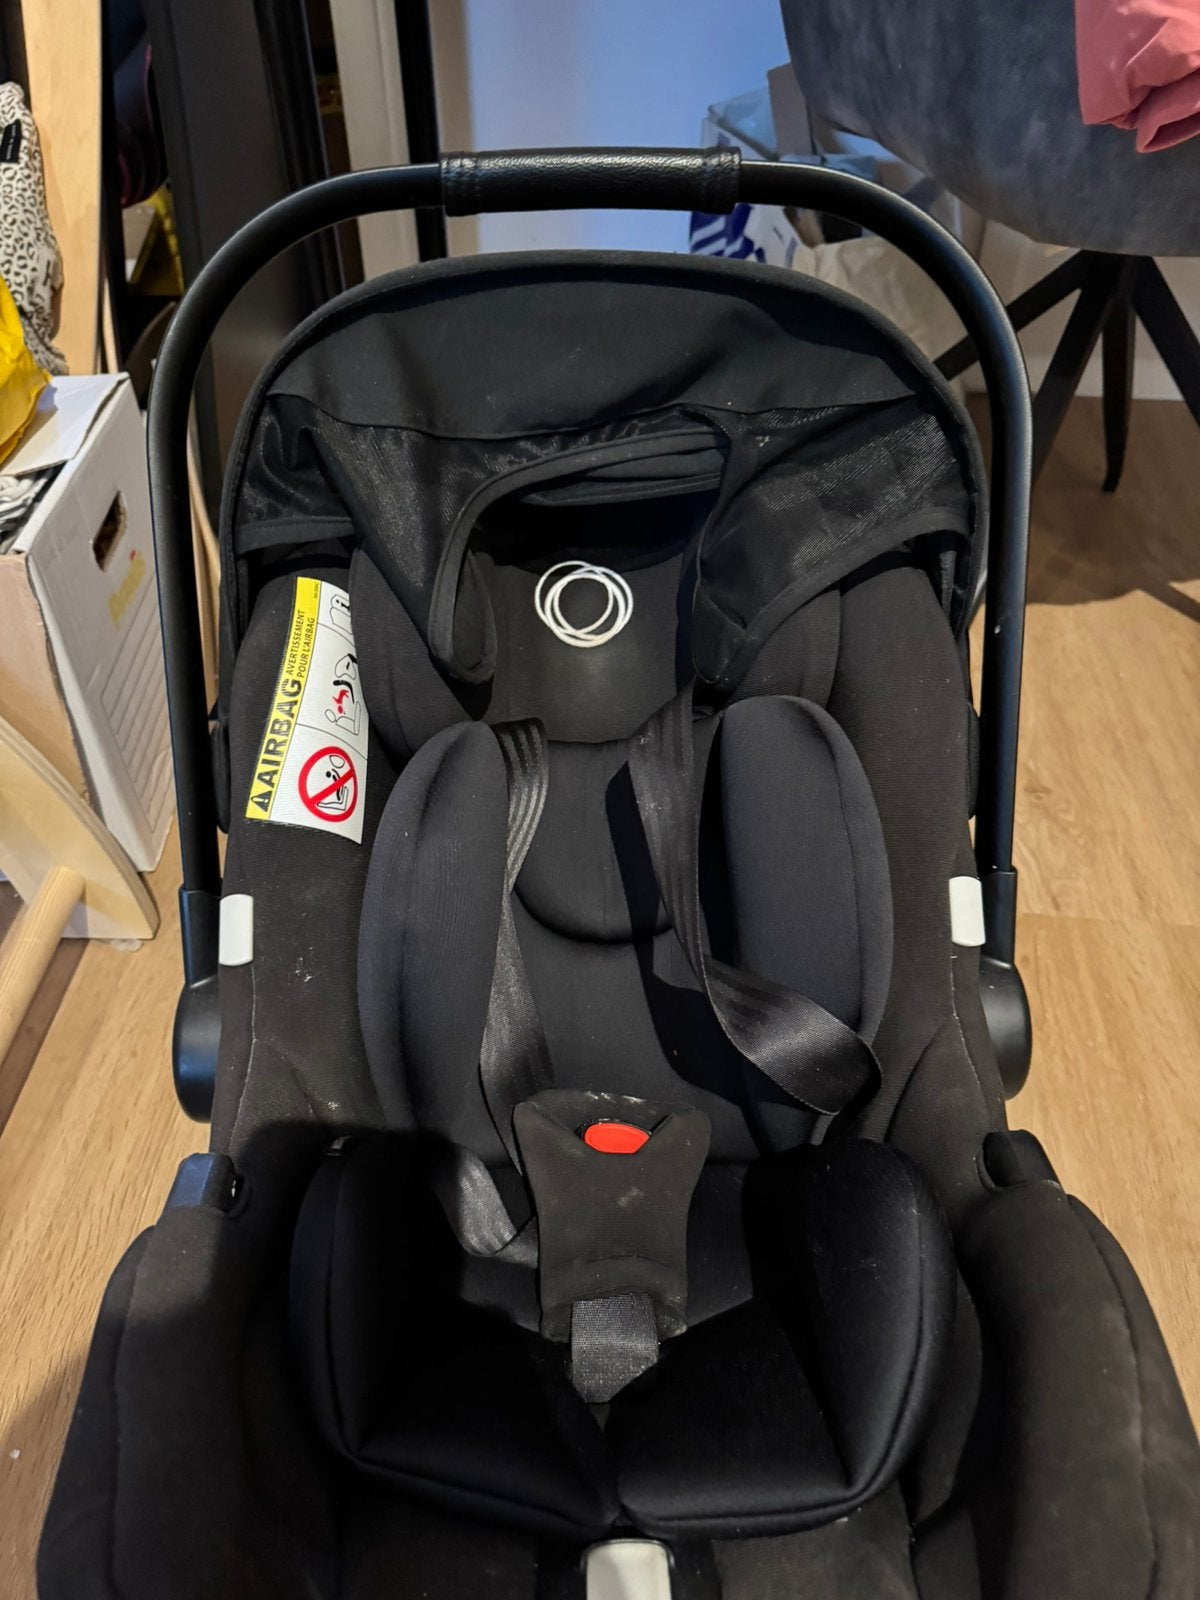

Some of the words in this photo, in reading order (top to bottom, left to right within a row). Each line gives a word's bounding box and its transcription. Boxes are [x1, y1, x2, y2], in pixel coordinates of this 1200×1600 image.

[286, 610, 305, 676] AVERTISSEMENT
[297, 652, 309, 678] POUR
[303, 617, 315, 651] L'AIRBAG
[257, 678, 302, 788] AIRBAG
